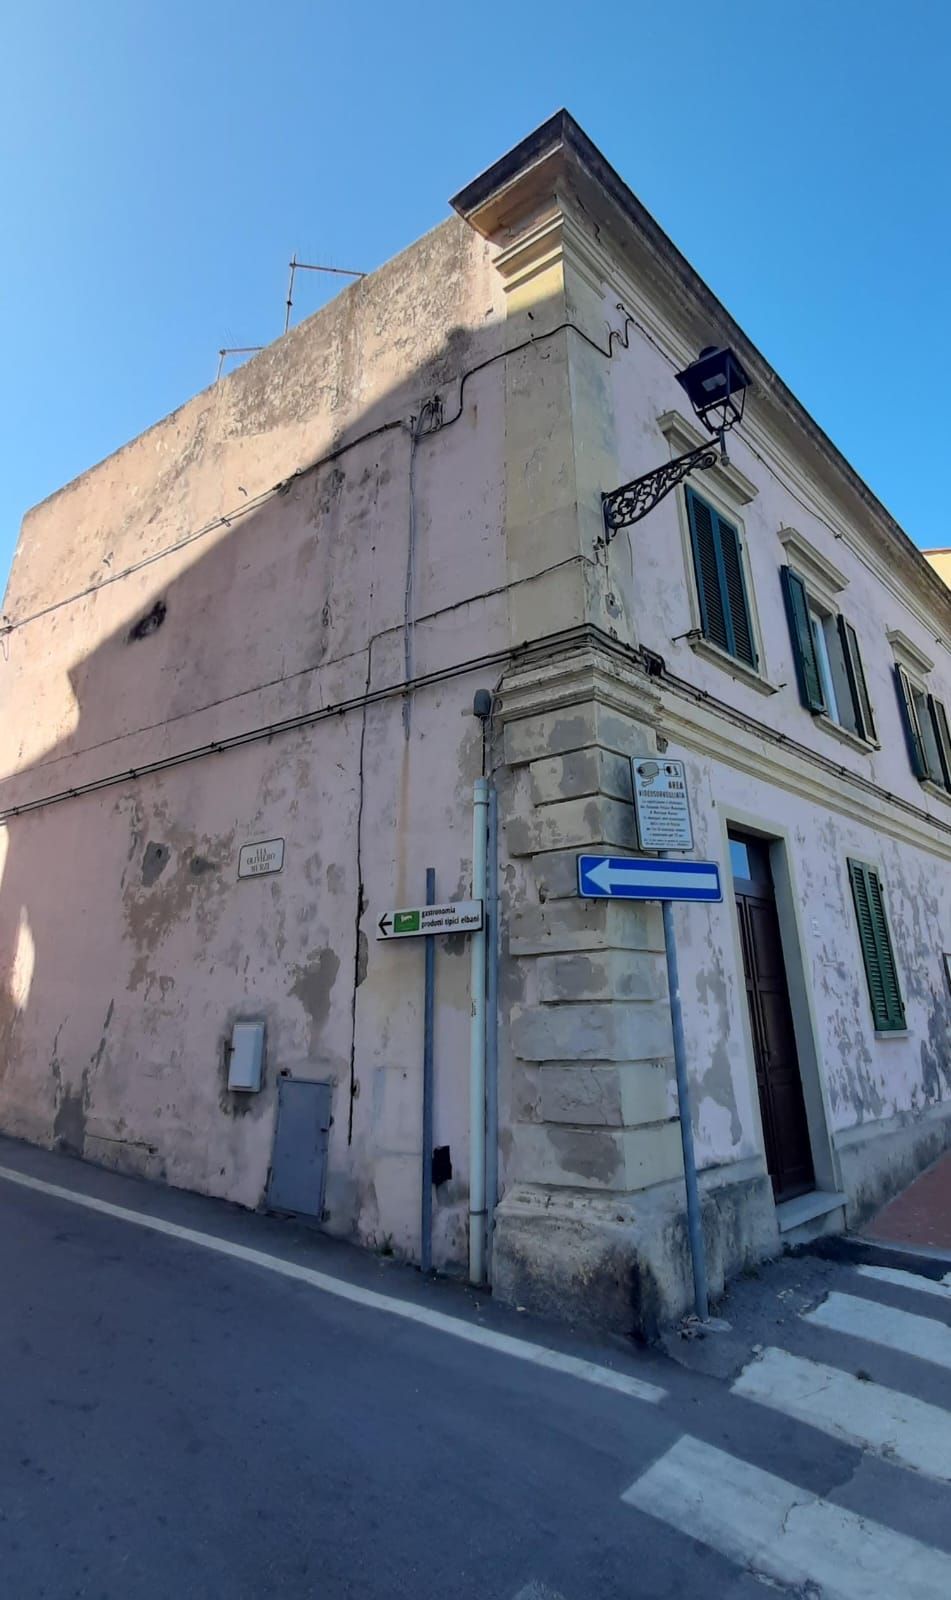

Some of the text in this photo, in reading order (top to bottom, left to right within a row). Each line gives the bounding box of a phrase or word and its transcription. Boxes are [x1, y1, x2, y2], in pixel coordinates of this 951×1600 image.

[668, 781, 684, 789] AREA
[256, 848, 267, 856] VIA
[422, 906, 456, 918] gastronomia
[421, 914, 480, 929] prodotti tipici elbani
